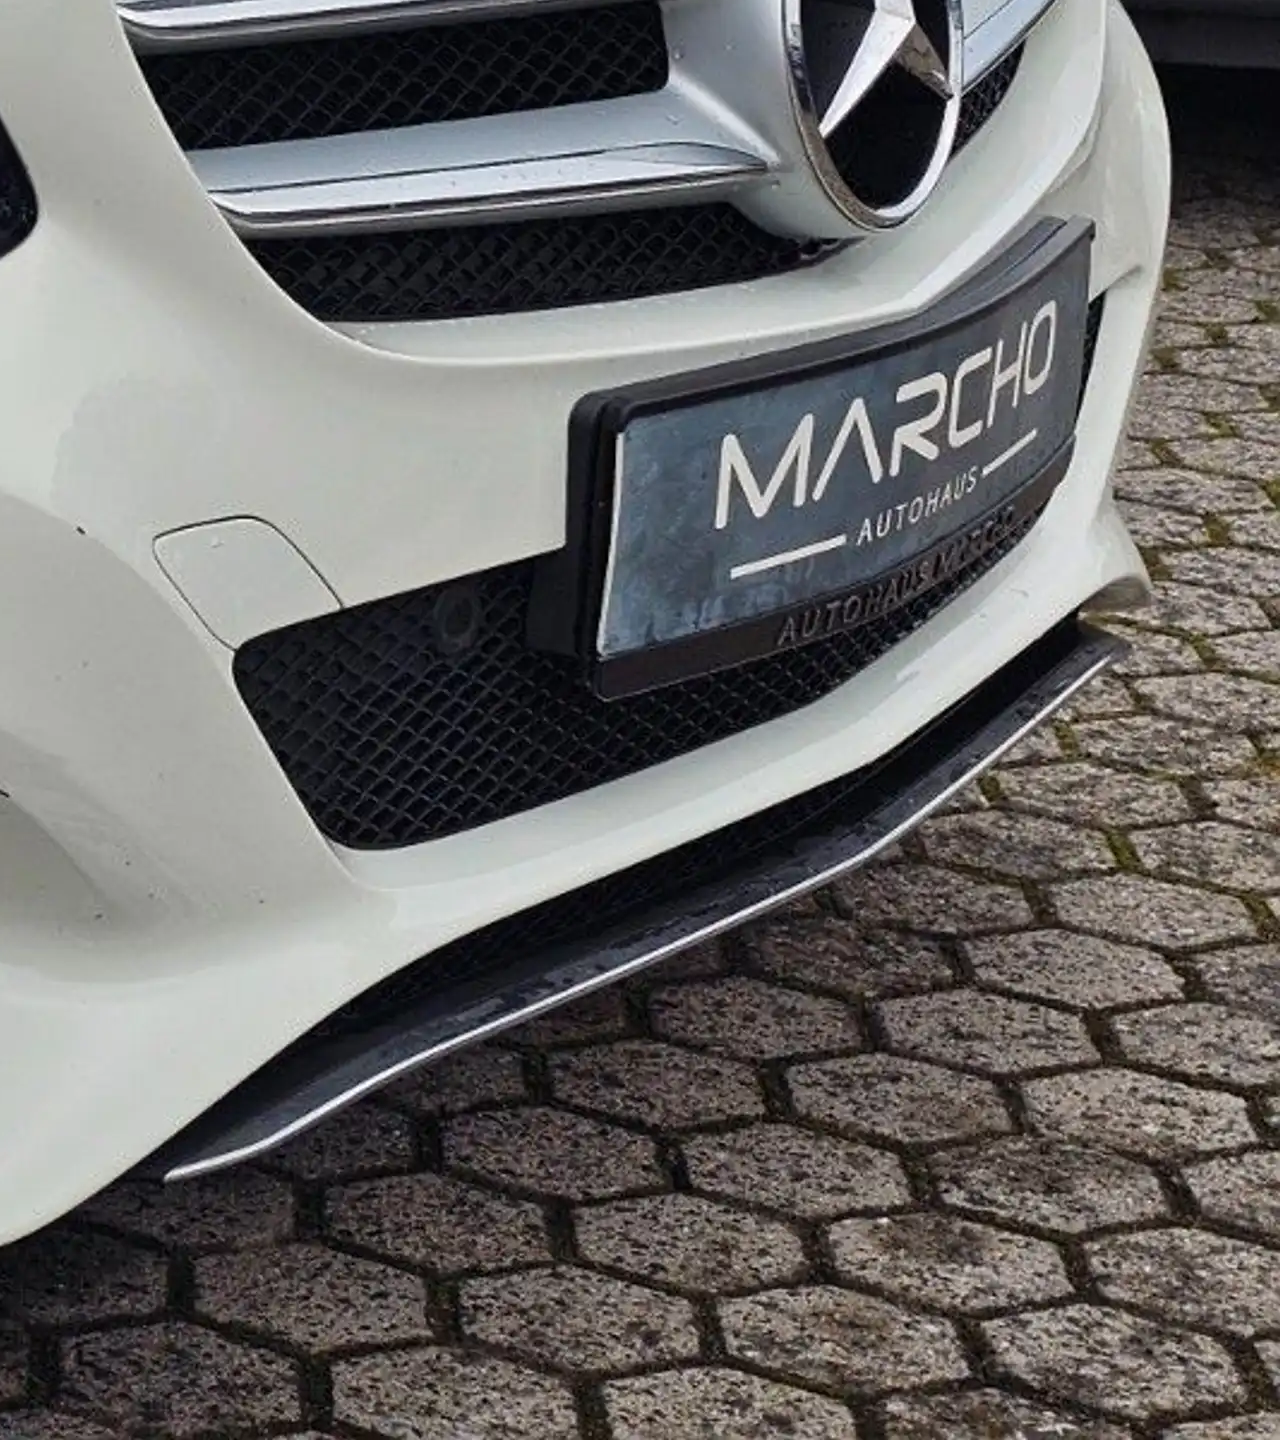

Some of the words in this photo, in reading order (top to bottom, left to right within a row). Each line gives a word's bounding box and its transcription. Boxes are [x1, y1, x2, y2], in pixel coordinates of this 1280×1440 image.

[713, 299, 1057, 530] MARCHO
[856, 466, 977, 546] AUTOHAUS
[776, 559, 930, 646] AUTOHAUS
